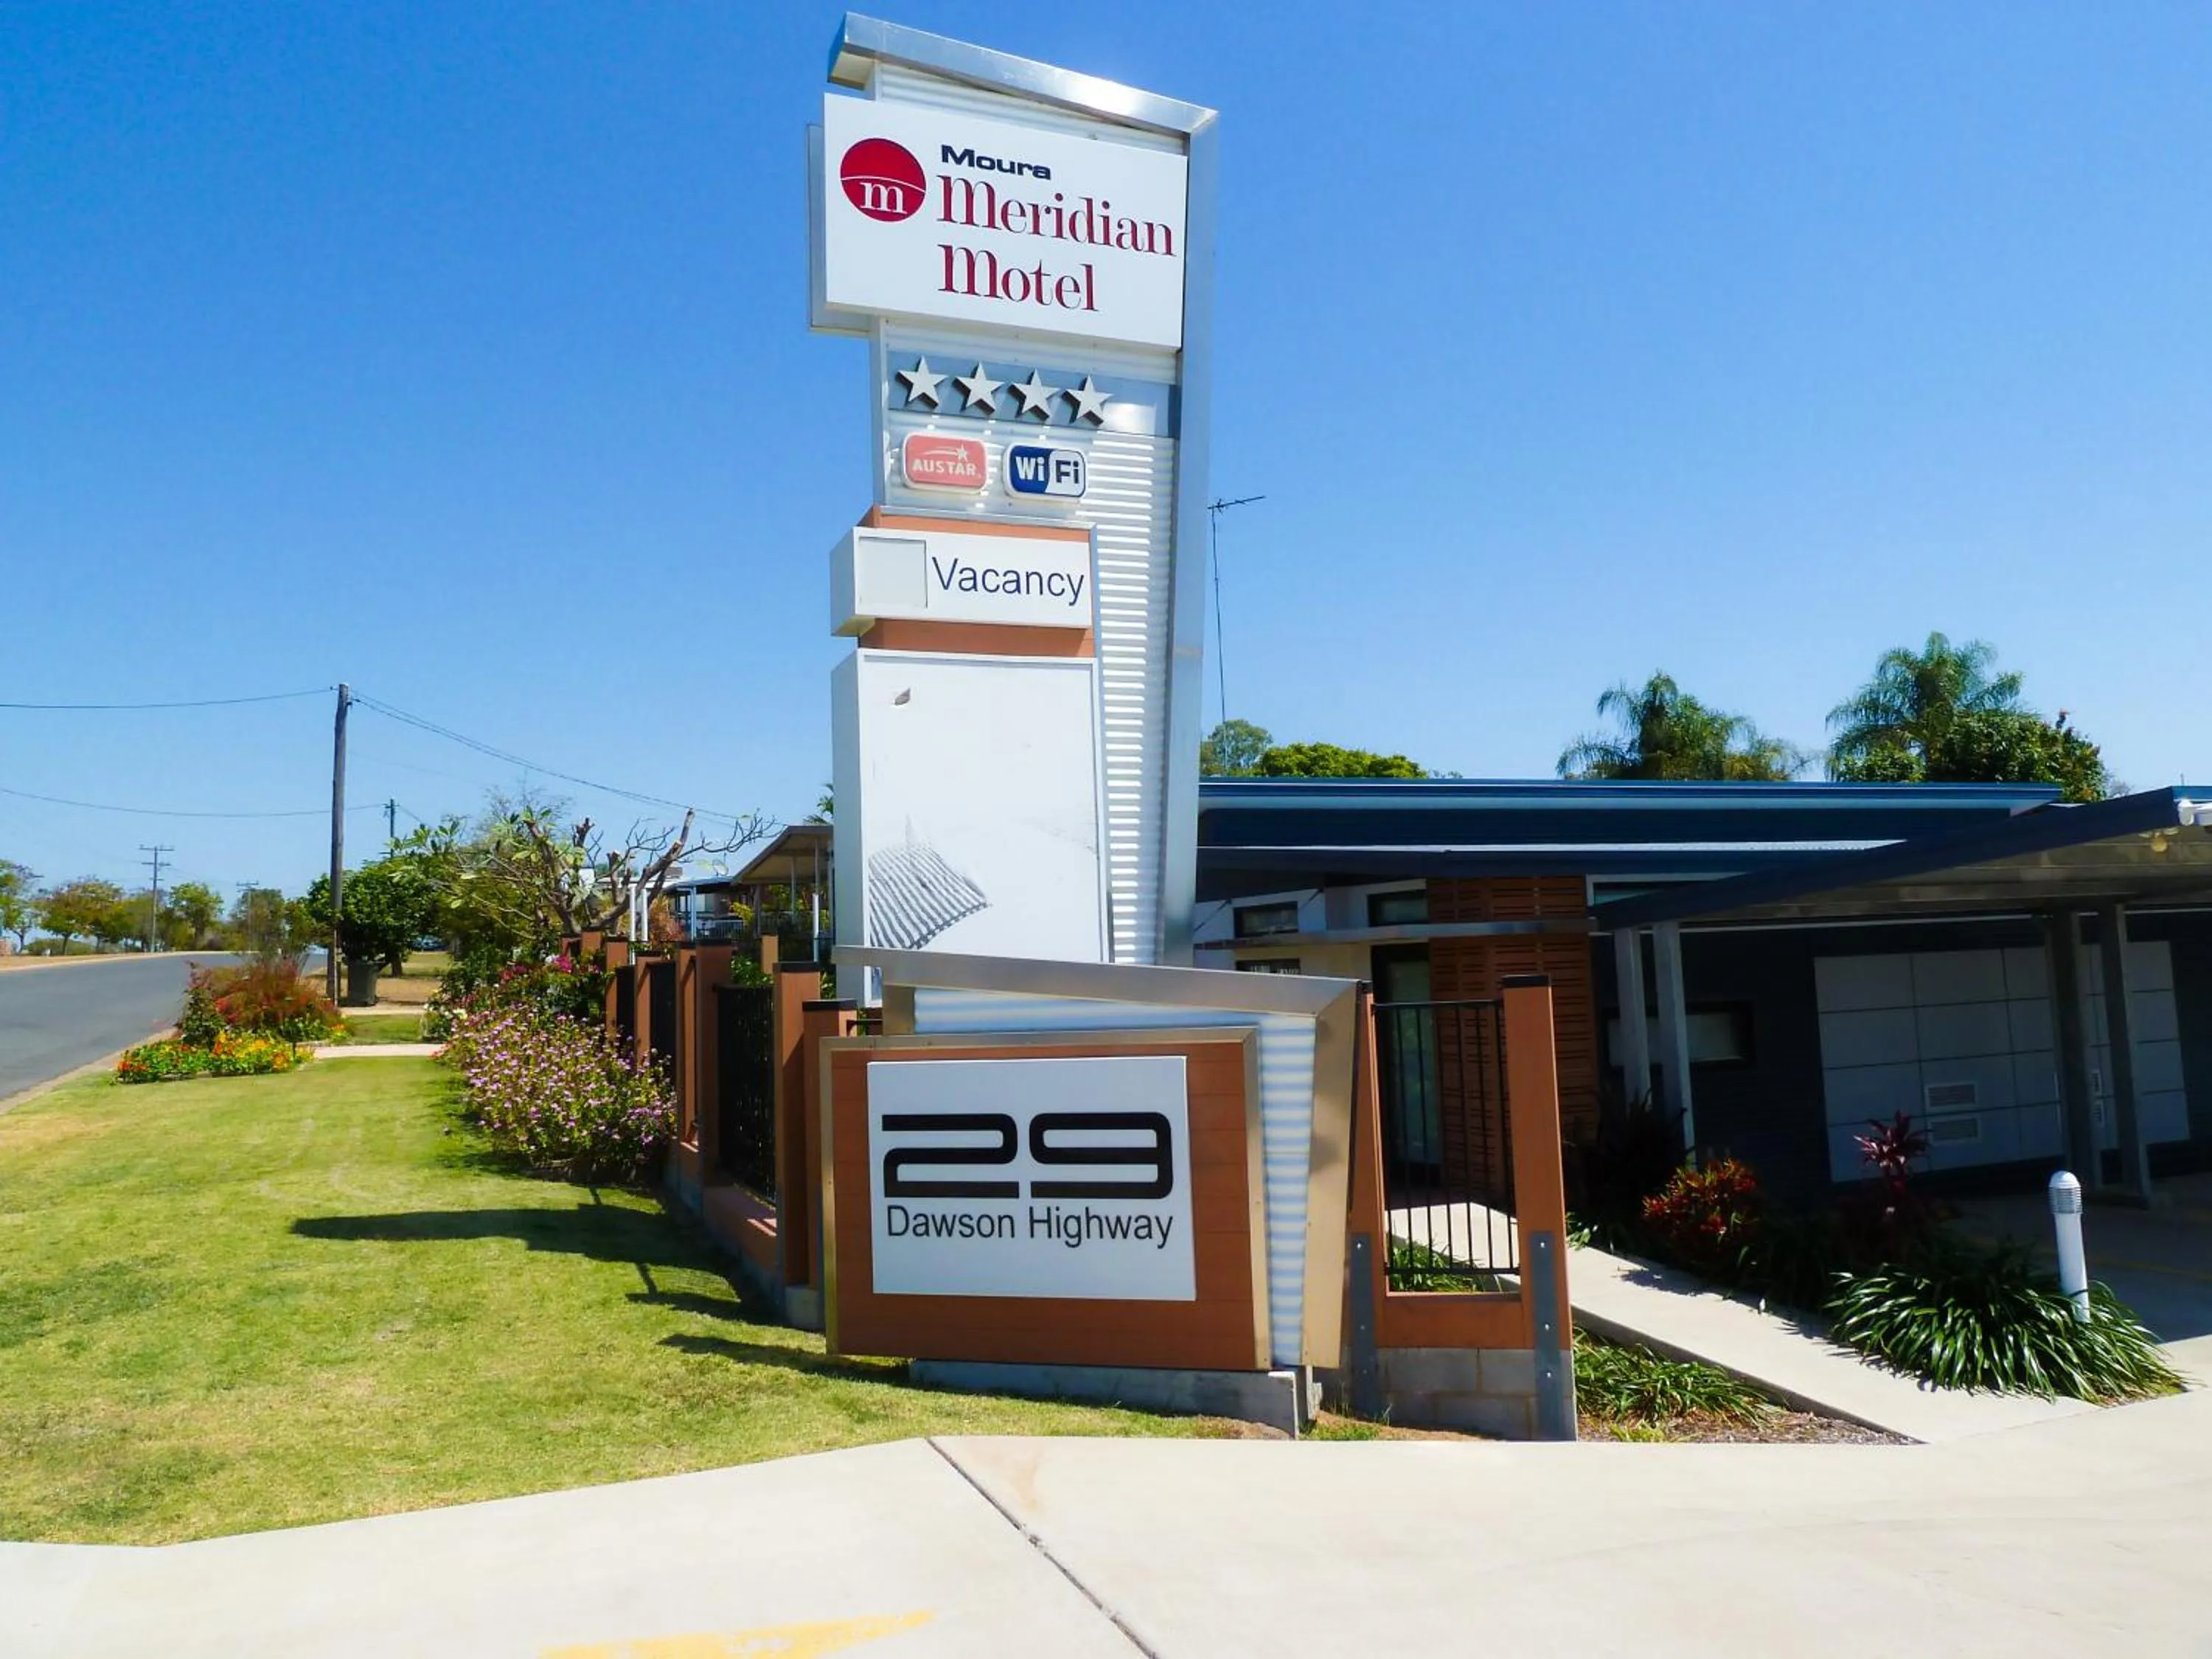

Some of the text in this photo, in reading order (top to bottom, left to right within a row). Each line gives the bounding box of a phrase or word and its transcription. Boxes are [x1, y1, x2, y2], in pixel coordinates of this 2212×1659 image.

[941, 145, 1051, 181] Moura
[912, 459, 978, 477] AUSTAR
[932, 557, 1085, 606] Vacancy
[882, 1112, 1173, 1199] 29
[887, 1205, 1173, 1249] Dawson Highway
